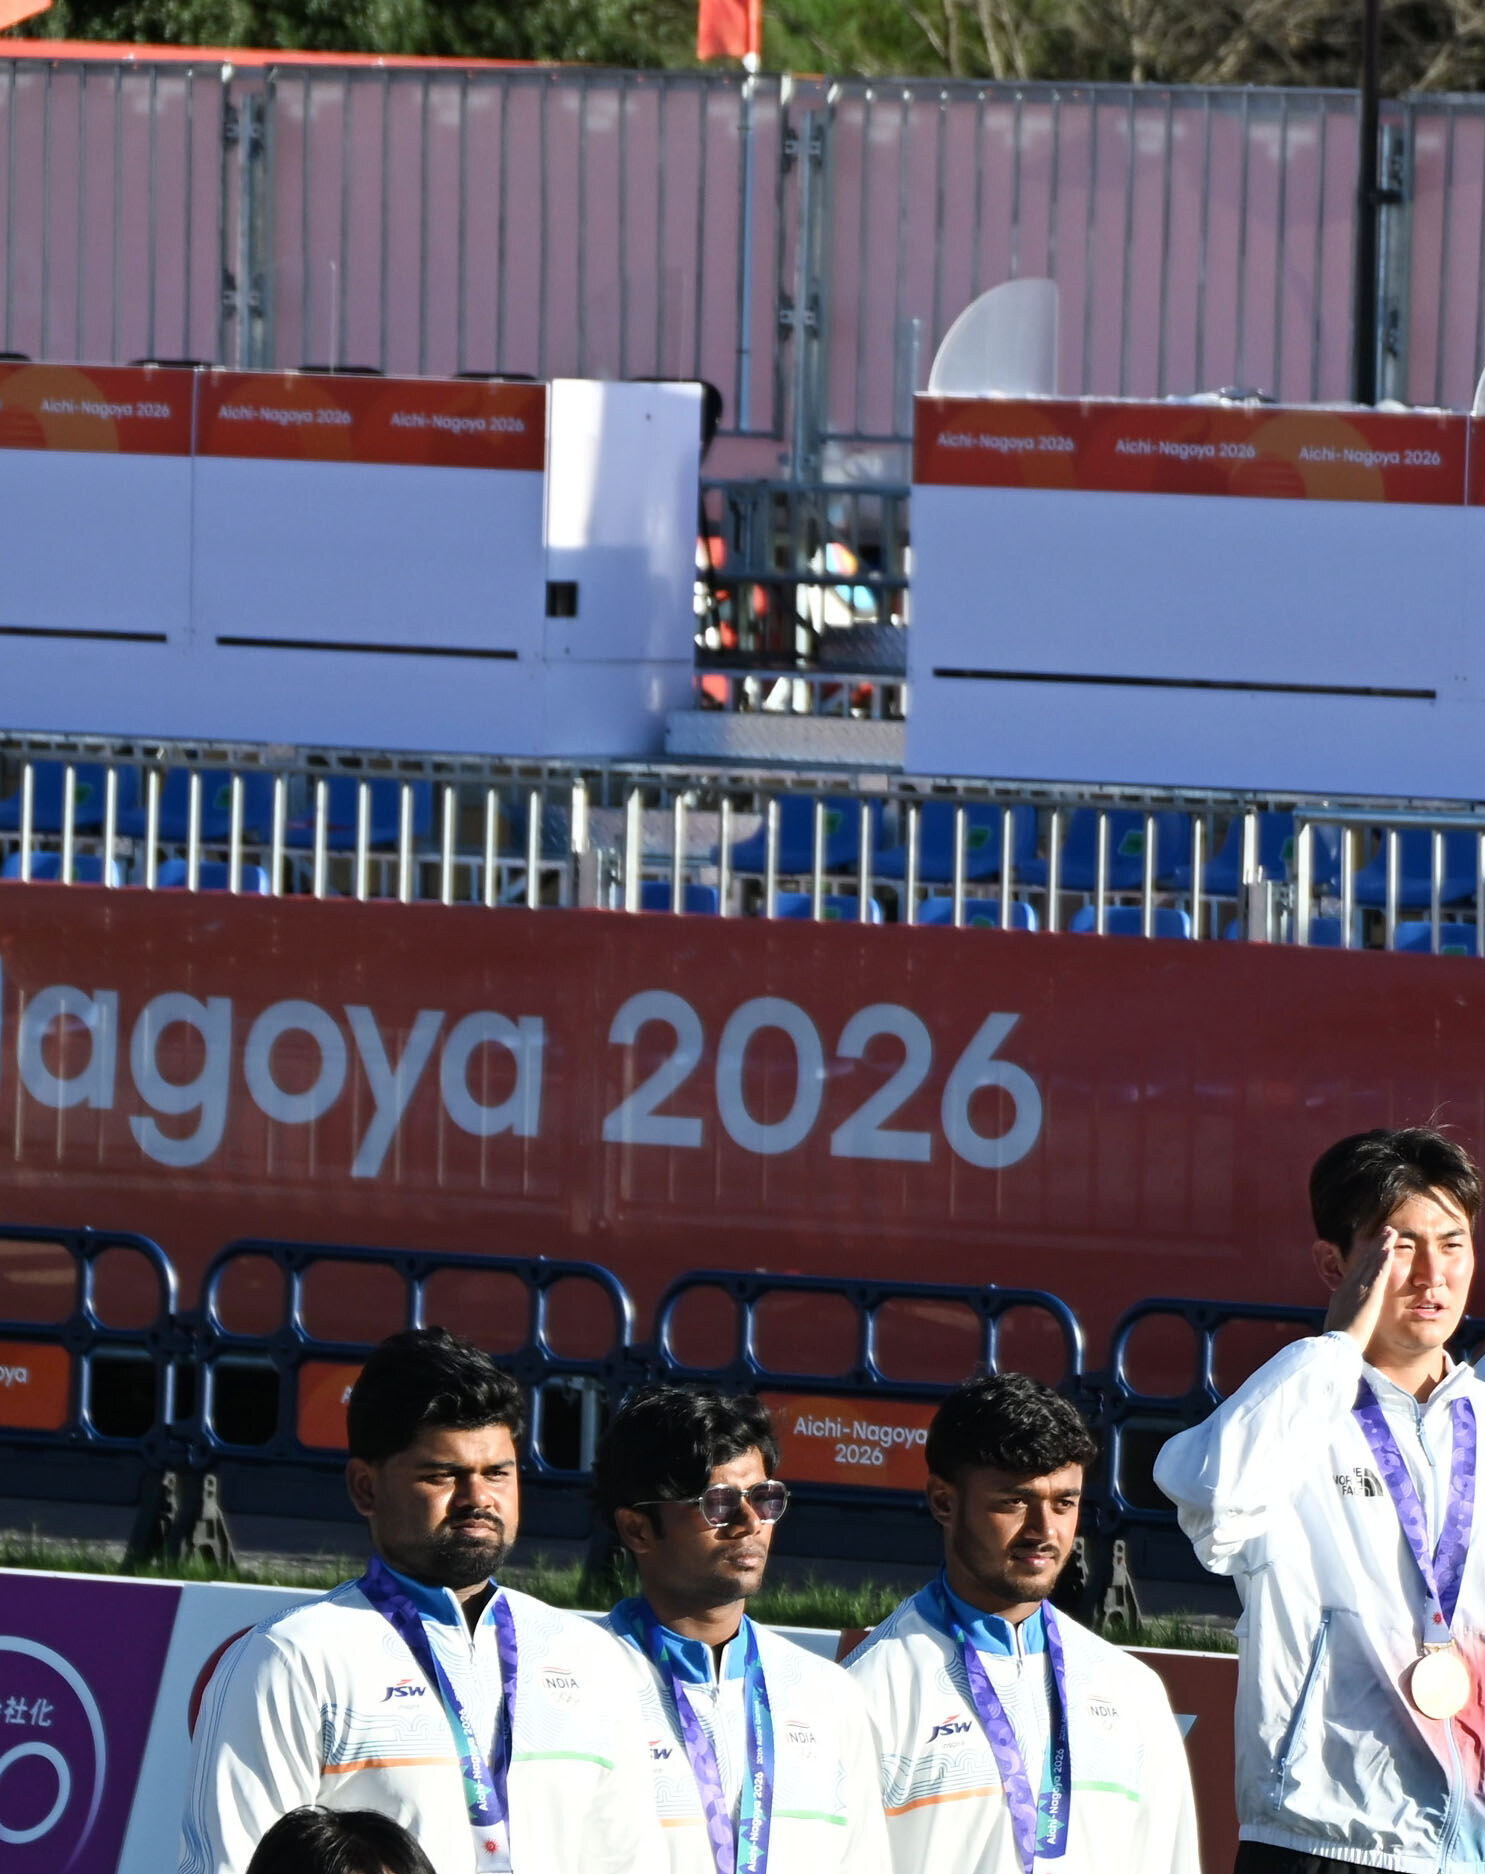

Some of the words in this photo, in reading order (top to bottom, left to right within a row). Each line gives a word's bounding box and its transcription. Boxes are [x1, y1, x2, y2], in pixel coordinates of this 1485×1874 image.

[41, 397, 133, 418] Aichi-Nagoya
[136, 402, 170, 419] 2026
[218, 404, 314, 426] Aichi-Nagoya
[317, 409, 351, 425] 2026
[390, 411, 486, 434] Aichi-Nagoya
[489, 416, 524, 433] 2026
[937, 430, 1035, 455] Aichi-Nagoya
[1037, 435, 1075, 453] 2026
[1115, 436, 1216, 462] Aichi-Nagoya
[1219, 441, 1256, 460] 2026
[1298, 444, 1401, 469] Aichi-Nagoya
[1403, 449, 1441, 467] 2026
[0, 955, 544, 1179] agoya
[602, 989, 1043, 1170] 2026
[793, 1415, 928, 1450] Aichi-Nagoya
[834, 1443, 884, 1465] 2026
[380, 1684, 427, 1703] JSW
[0, 1696, 54, 1726] 社化
[926, 1720, 973, 1744] JSW
[1053, 1748, 1065, 1774] 2026
[753, 1771, 764, 1799] 2026
[1046, 1775, 1063, 1845] Aichi-Nagoya
